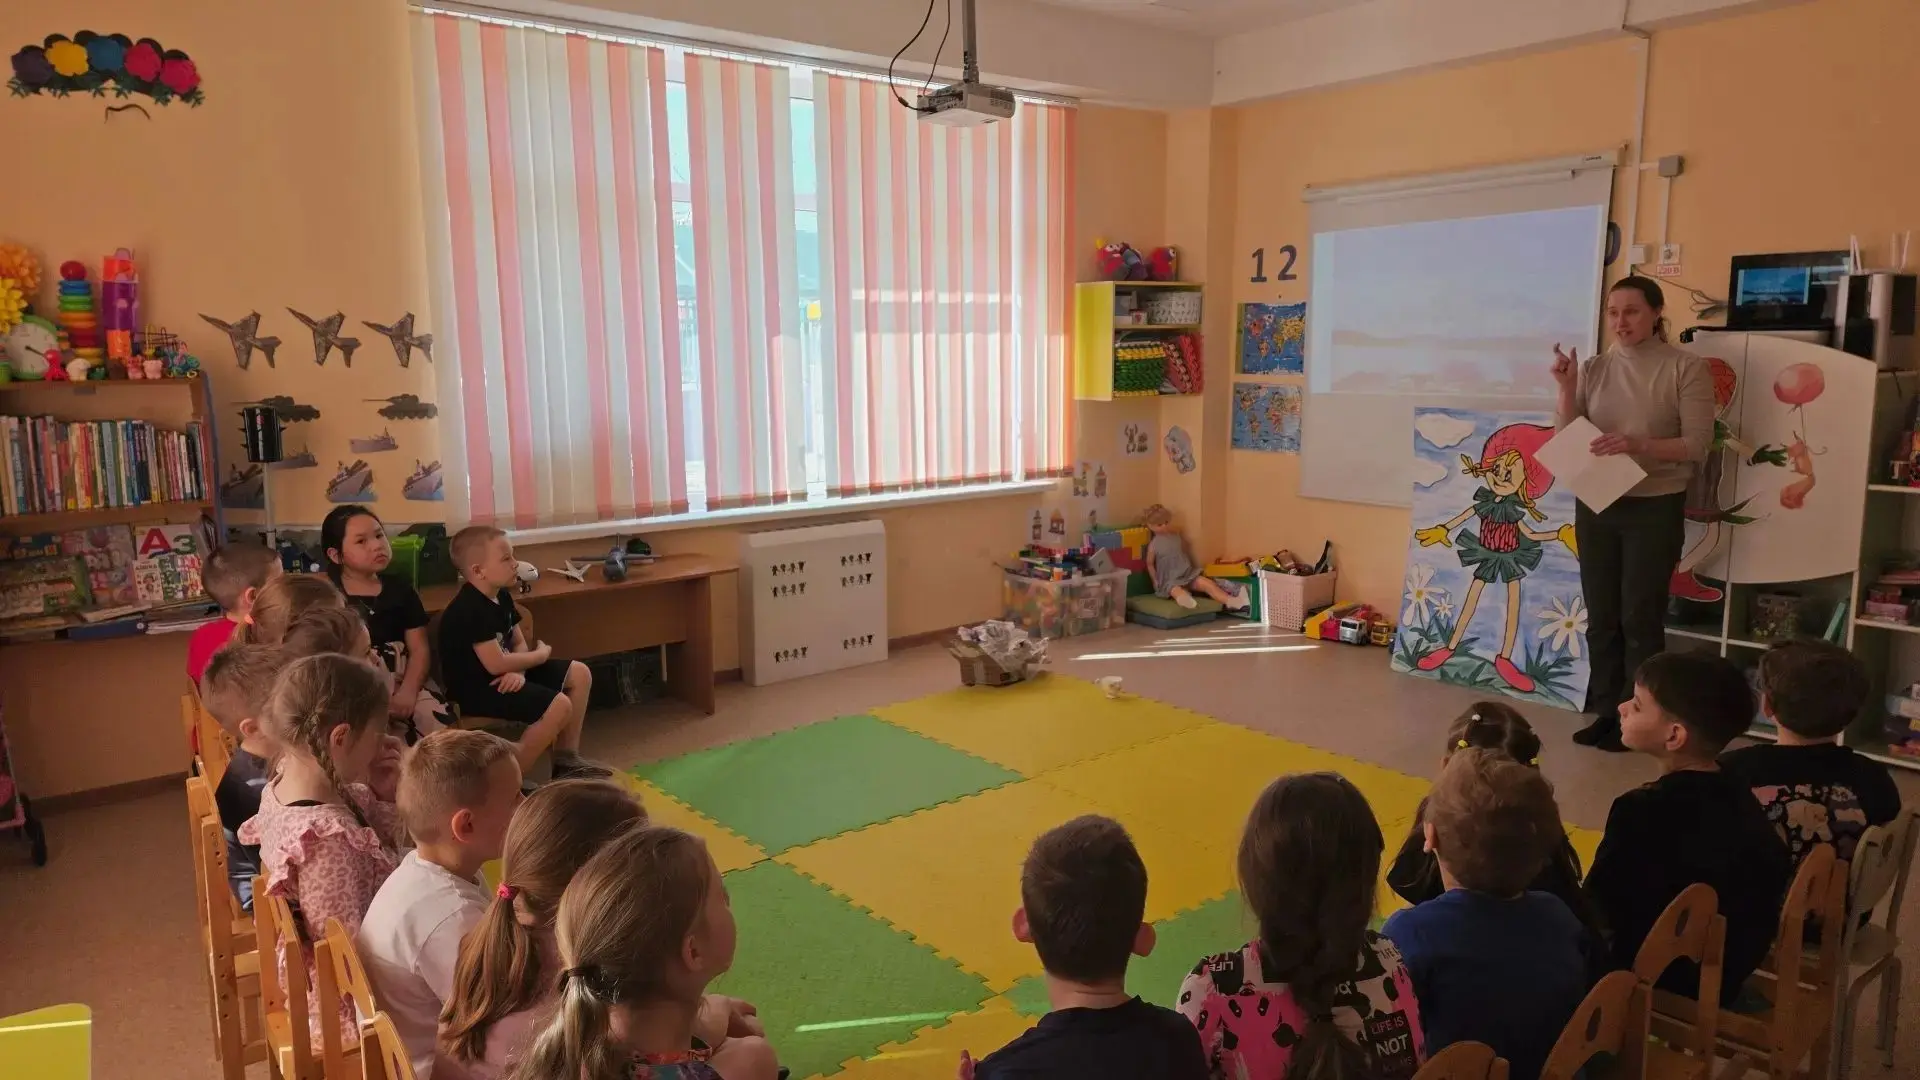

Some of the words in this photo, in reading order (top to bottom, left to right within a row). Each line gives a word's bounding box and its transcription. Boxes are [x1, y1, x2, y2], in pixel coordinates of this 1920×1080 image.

[1371, 1018, 1393, 1034] LIFE
[1394, 1016, 1405, 1028] IS
[1375, 1033, 1409, 1056] NOT
